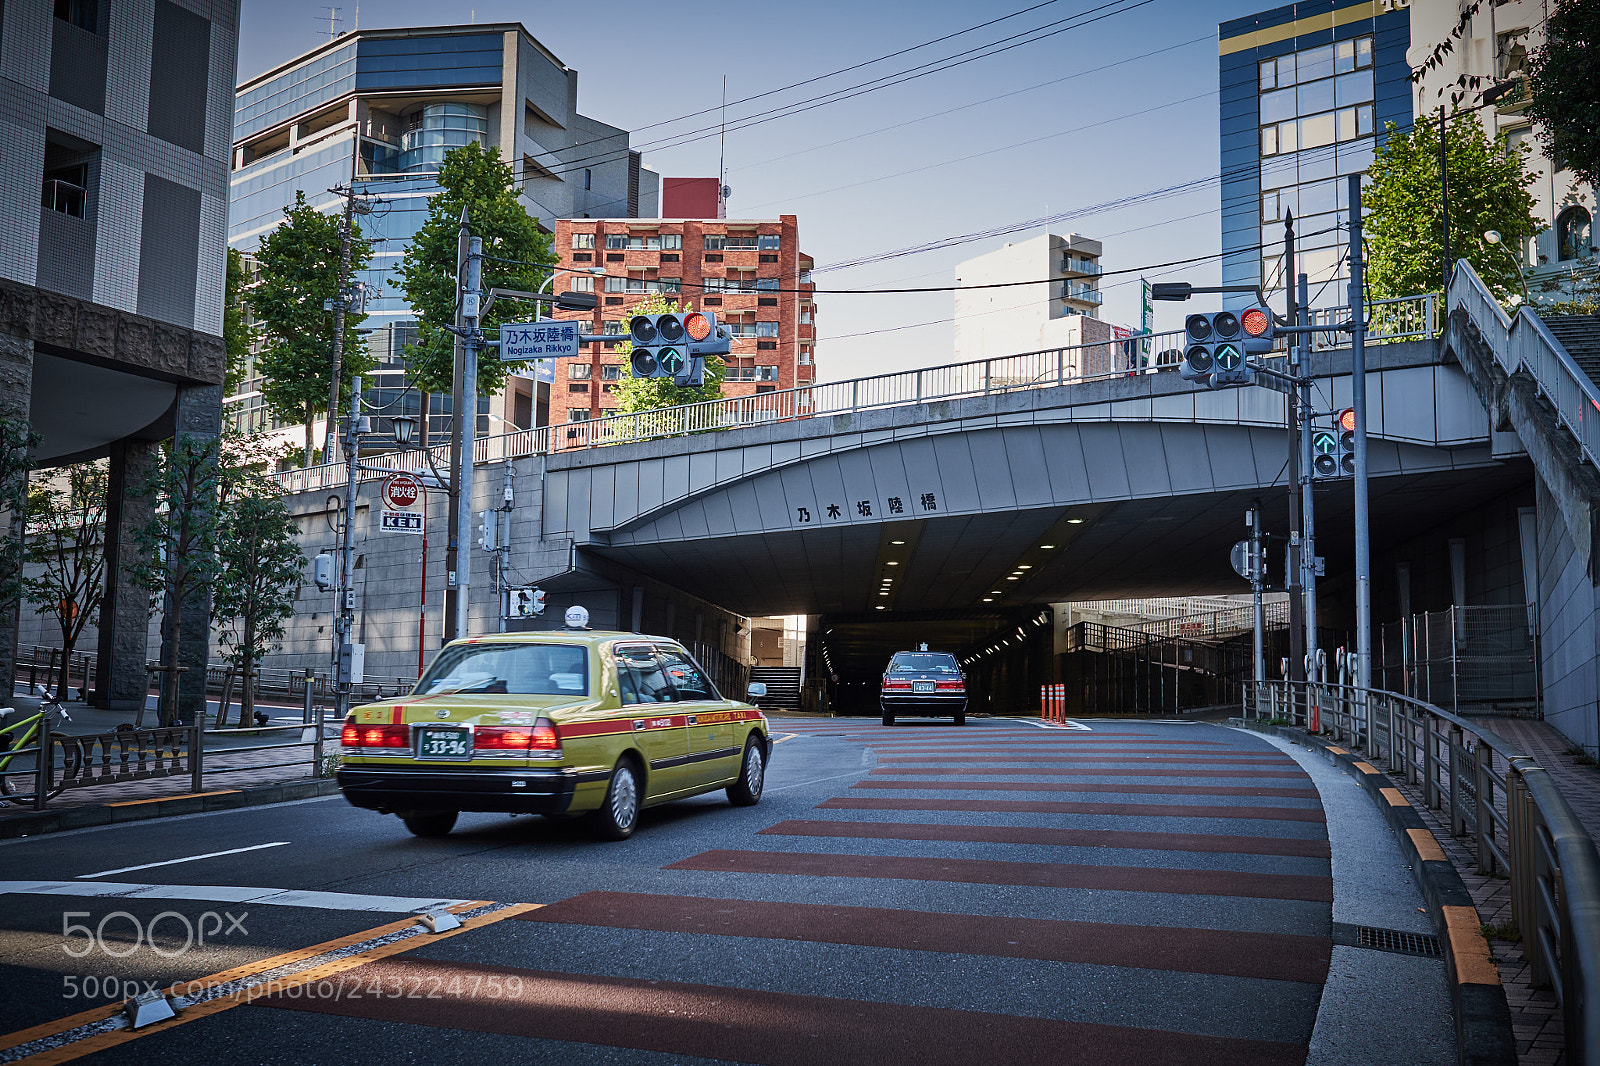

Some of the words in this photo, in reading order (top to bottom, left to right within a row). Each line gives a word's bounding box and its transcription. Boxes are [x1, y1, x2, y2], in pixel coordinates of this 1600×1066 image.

[506, 327, 573, 344] 乃木坂陸橋
[507, 346, 543, 356] Nogizaka
[545, 344, 572, 353] Rikkyo
[390, 486, 416, 498] 消火栓
[797, 493, 937, 523] 乃木坂陸橋
[386, 517, 417, 527] KEN
[429, 740, 466, 754] 33-96
